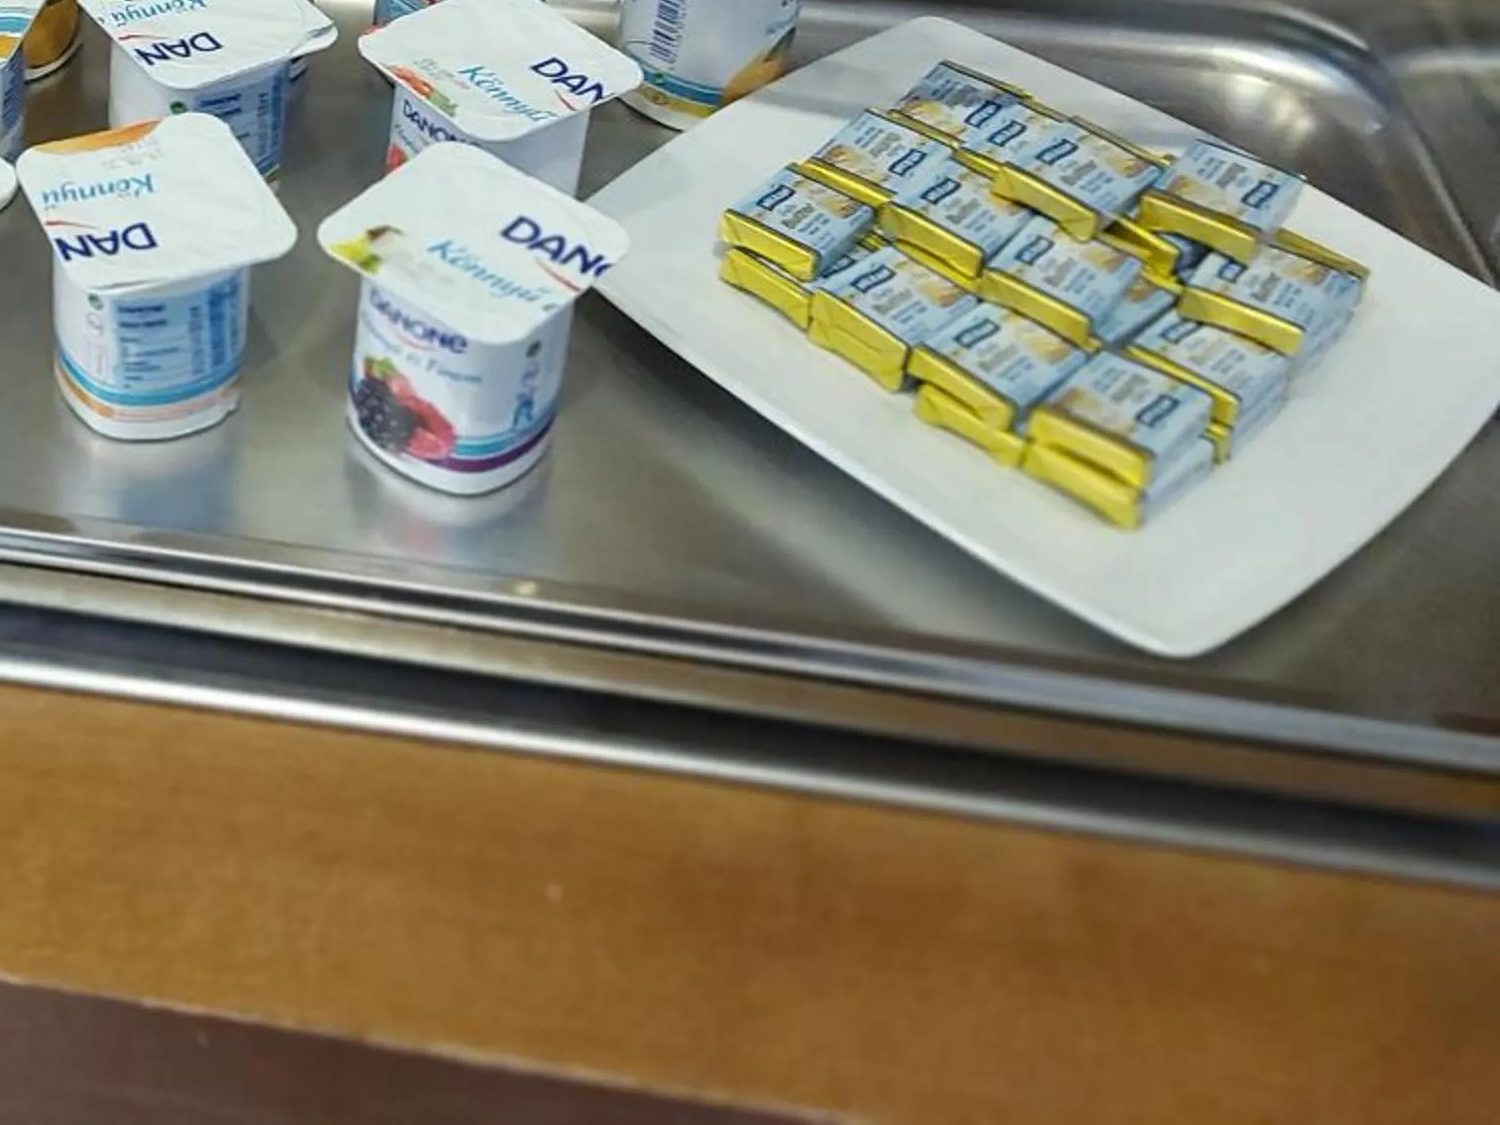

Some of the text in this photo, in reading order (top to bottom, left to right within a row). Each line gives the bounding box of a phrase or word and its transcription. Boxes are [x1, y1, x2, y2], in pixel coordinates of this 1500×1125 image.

[134, 32, 223, 65] DAN
[55, 222, 158, 261] DAN
[500, 216, 612, 276] DAN
